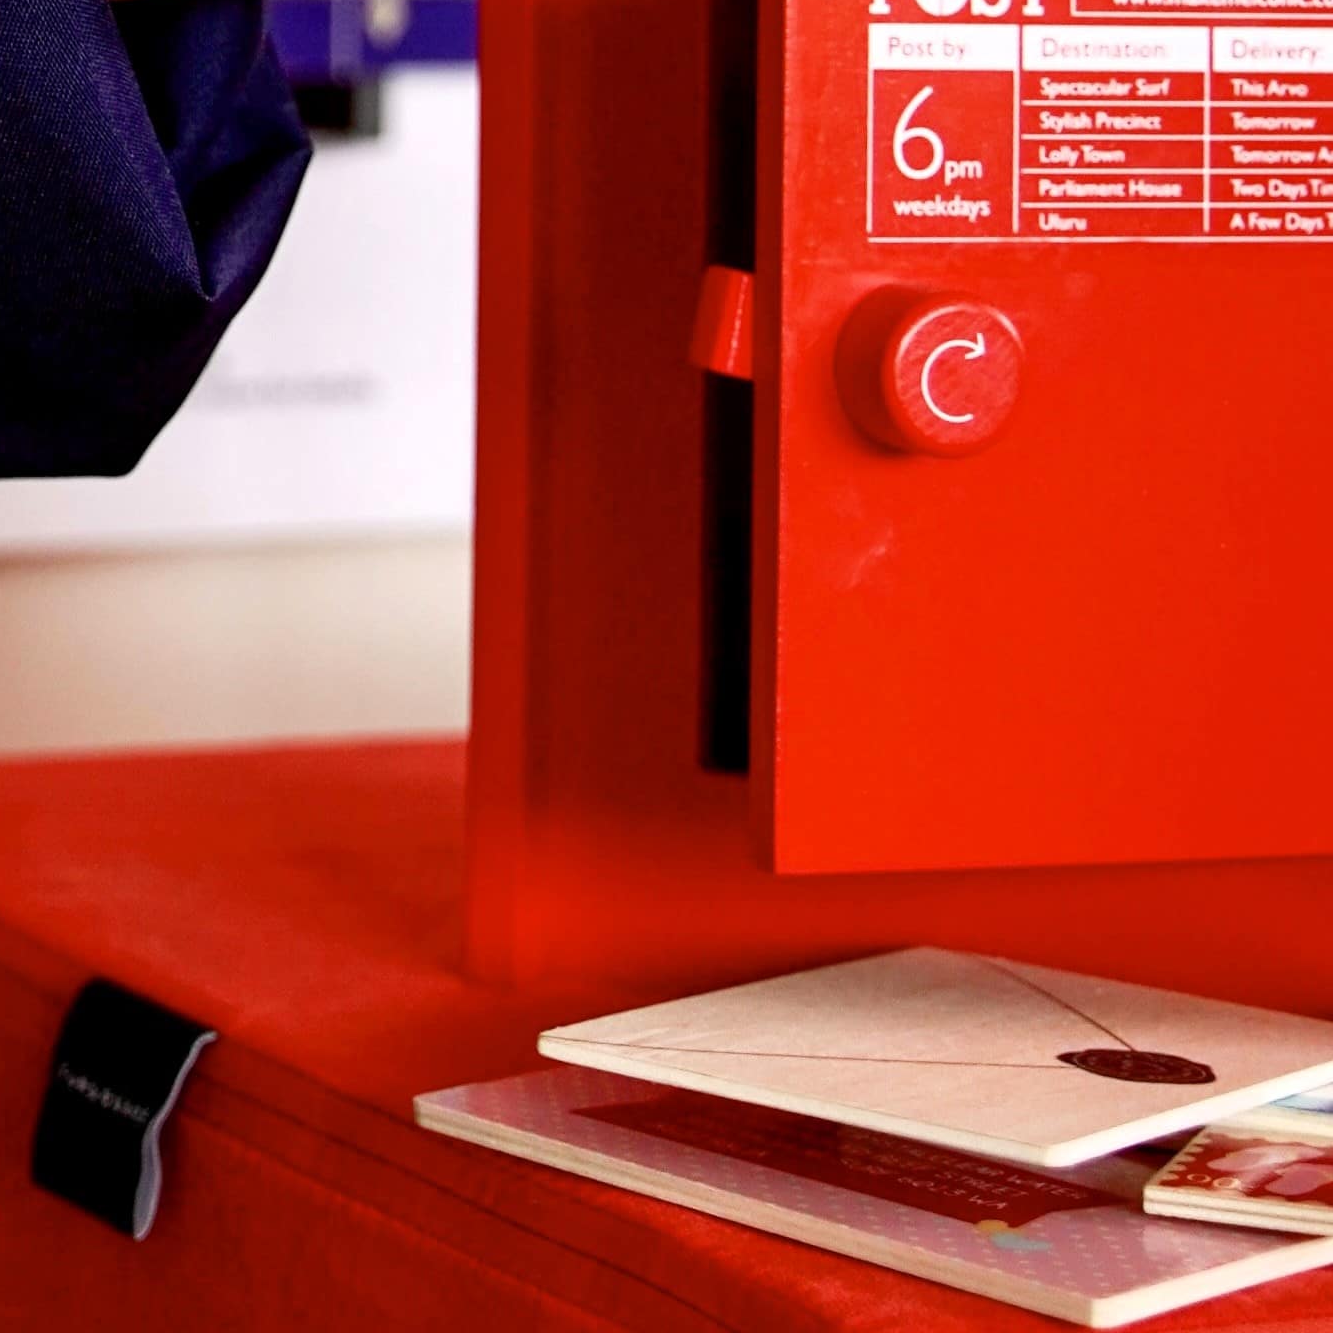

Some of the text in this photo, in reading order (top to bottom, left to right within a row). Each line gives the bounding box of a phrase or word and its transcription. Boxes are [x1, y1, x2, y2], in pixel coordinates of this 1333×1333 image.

[887, 36, 966, 60] Post by
[1039, 77, 1171, 99] Spectacular Surf
[1230, 78, 1310, 97] This Arvo
[1039, 111, 1163, 133] Stylish Precinct
[1230, 111, 1317, 131] Tomorrow
[1038, 145, 1126, 166] Lolly Town
[1230, 145, 1316, 164] Tomorrow
[1038, 179, 1183, 197] Parliament House
[1230, 179, 1265, 197] Two
[1268, 179, 1308, 200] Days
[893, 196, 991, 223] weekdays
[1038, 213, 1088, 231] Uluru
[1229, 212, 1245, 230] A
[1247, 212, 1282, 231] Few
[1284, 212, 1324, 234] Days
